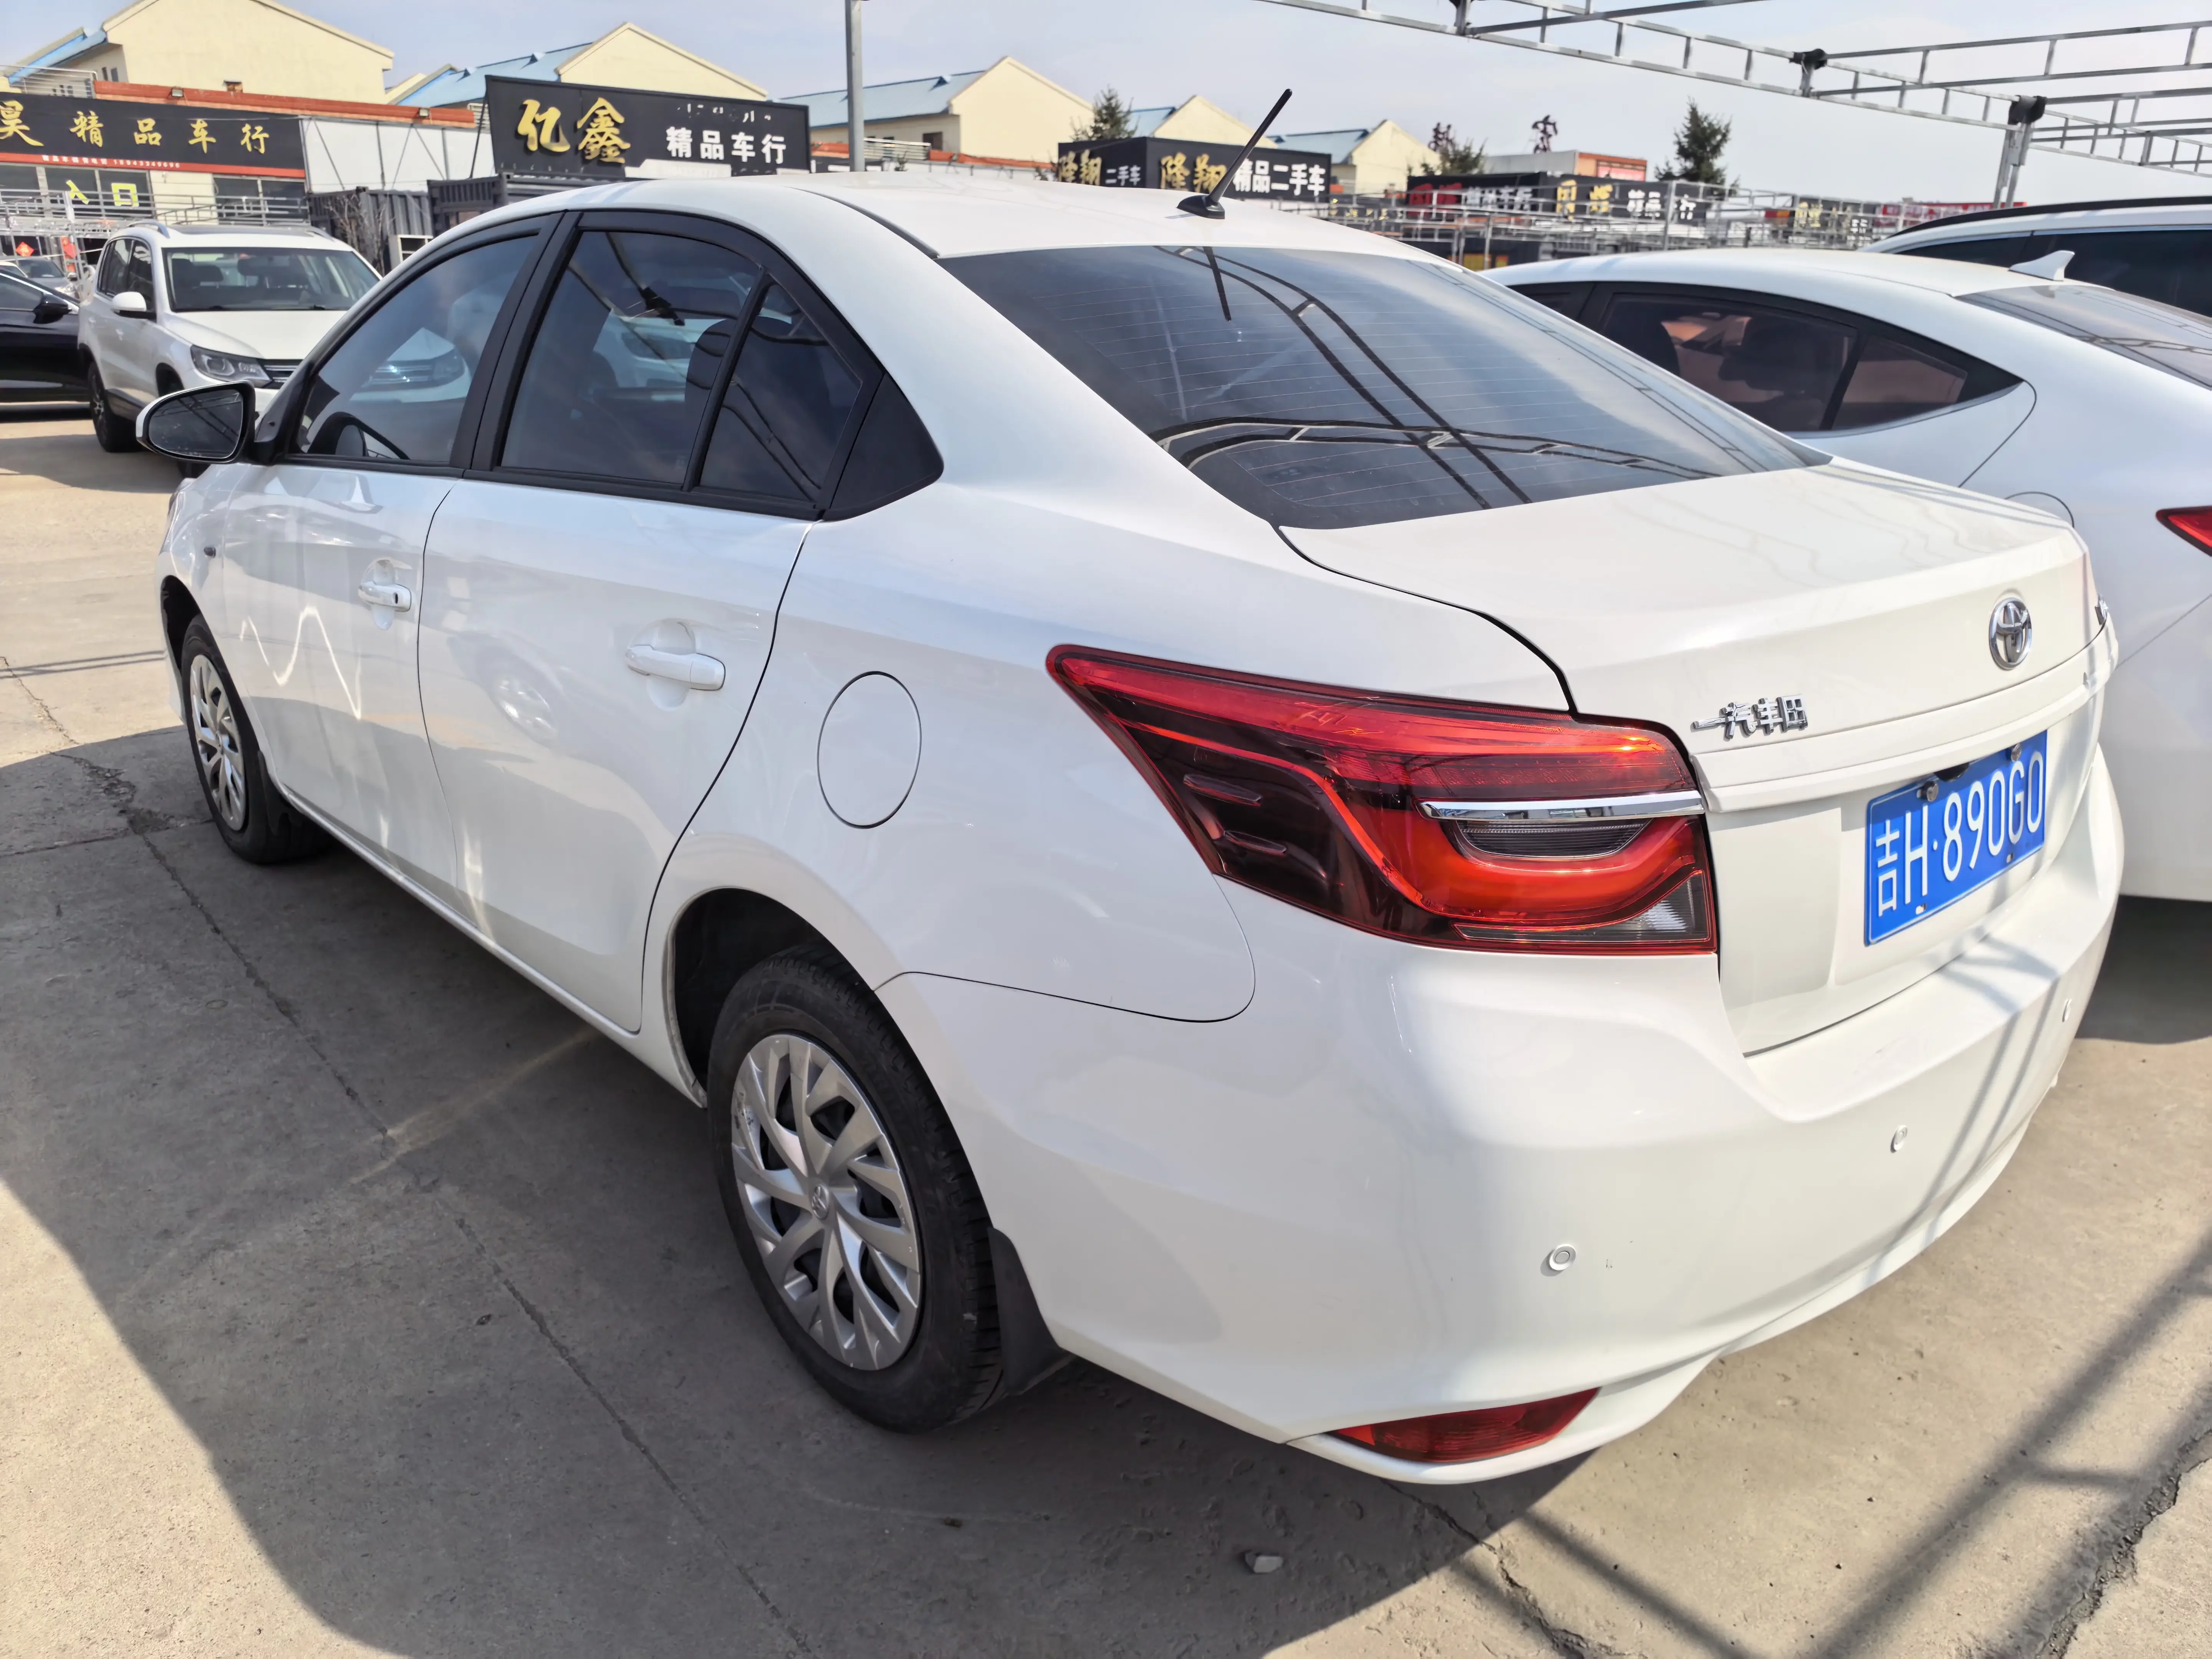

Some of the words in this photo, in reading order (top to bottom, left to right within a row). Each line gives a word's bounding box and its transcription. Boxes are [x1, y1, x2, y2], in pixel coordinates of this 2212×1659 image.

[517, 97, 631, 164] 亿鑫
[666, 126, 786, 164] 精品车行
[1105, 165, 1141, 186] 二手车
[1233, 158, 1326, 196] 精品二手车
[1692, 694, 1808, 740] 一汽丰田
